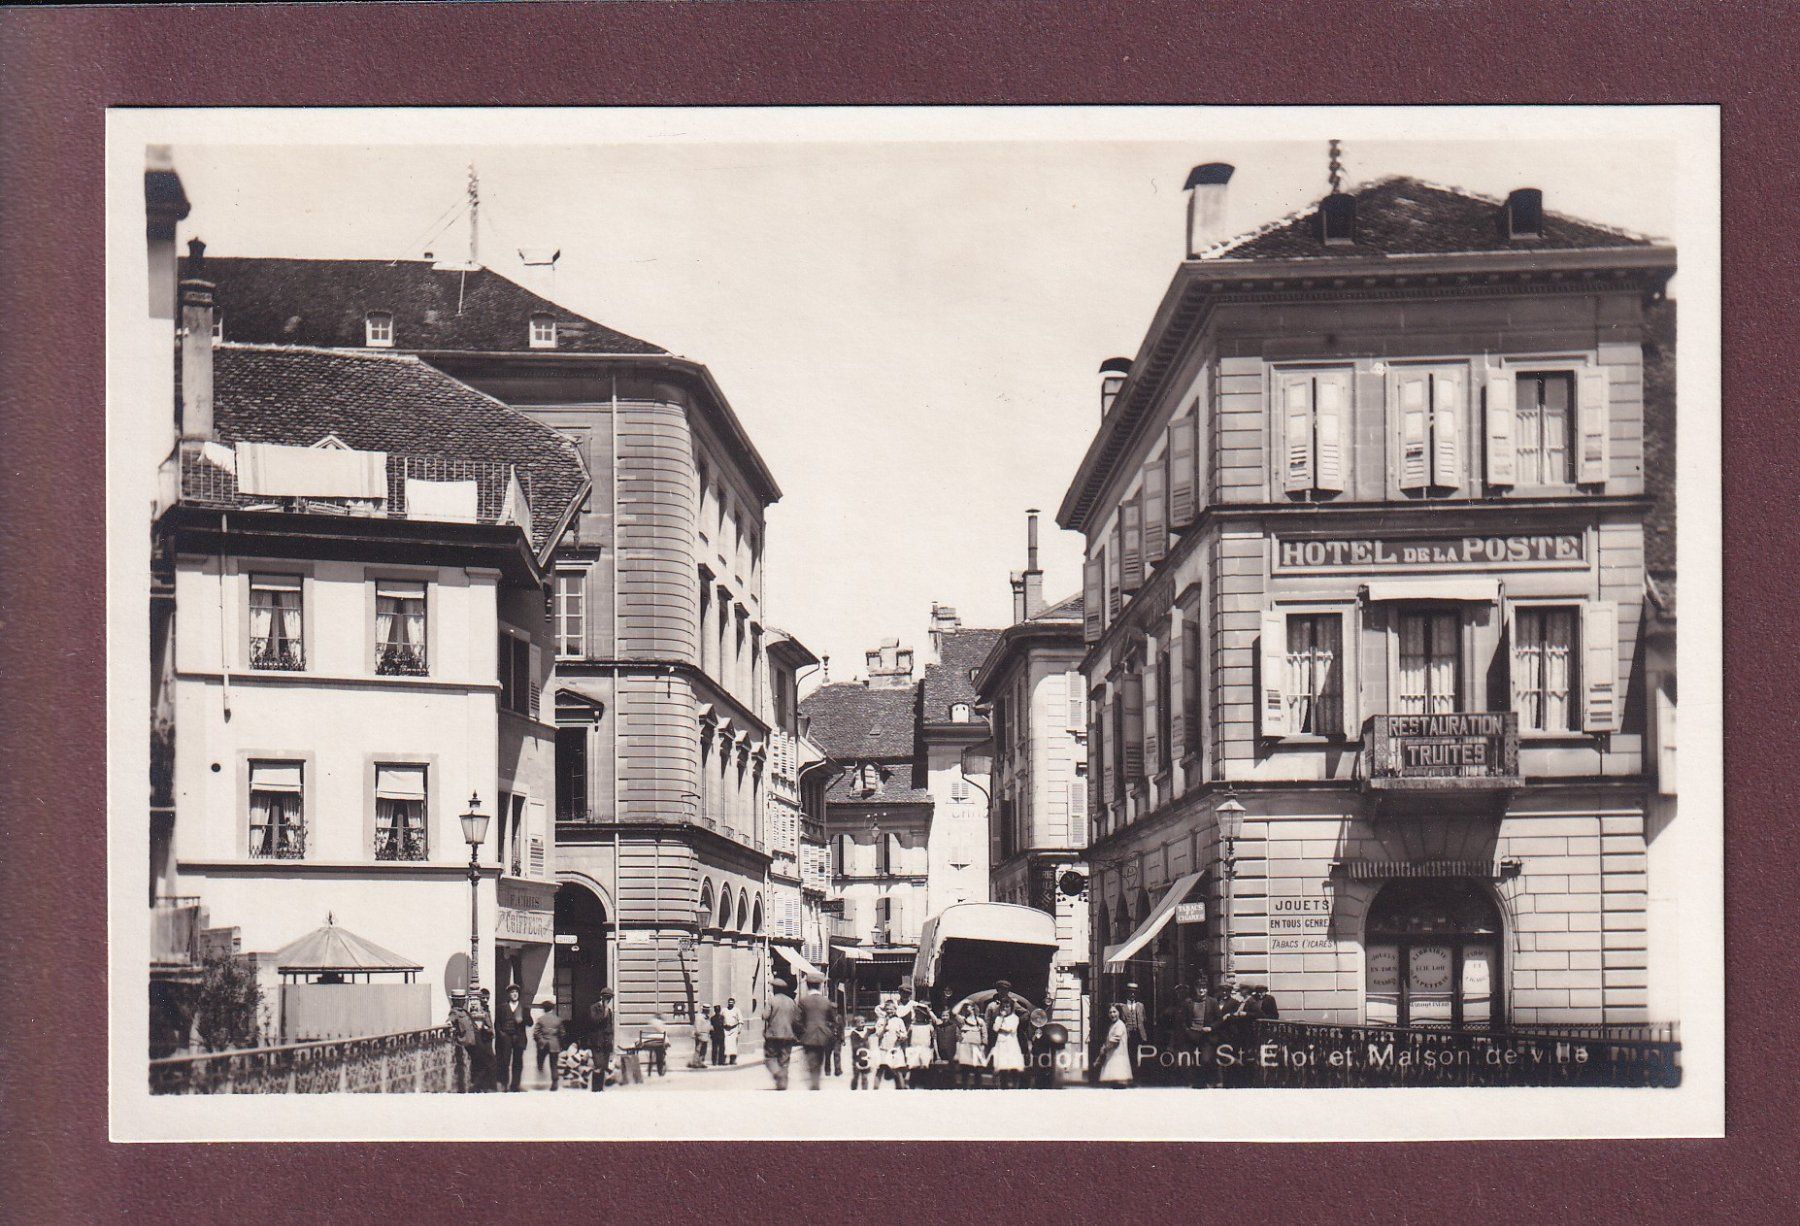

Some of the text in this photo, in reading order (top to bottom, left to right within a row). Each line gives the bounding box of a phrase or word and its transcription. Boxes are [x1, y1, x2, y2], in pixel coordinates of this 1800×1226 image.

[1283, 536, 1579, 566] HOTEL DE LA POSTE
[1388, 715, 1503, 737] RESTAURATION
[1407, 743, 1487, 767] TRUITES
[1275, 900, 1330, 911] JOUETS
[1270, 919, 1280, 928] EN
[1281, 919, 1301, 928] TOUS
[1271, 939, 1299, 950] TABACS
